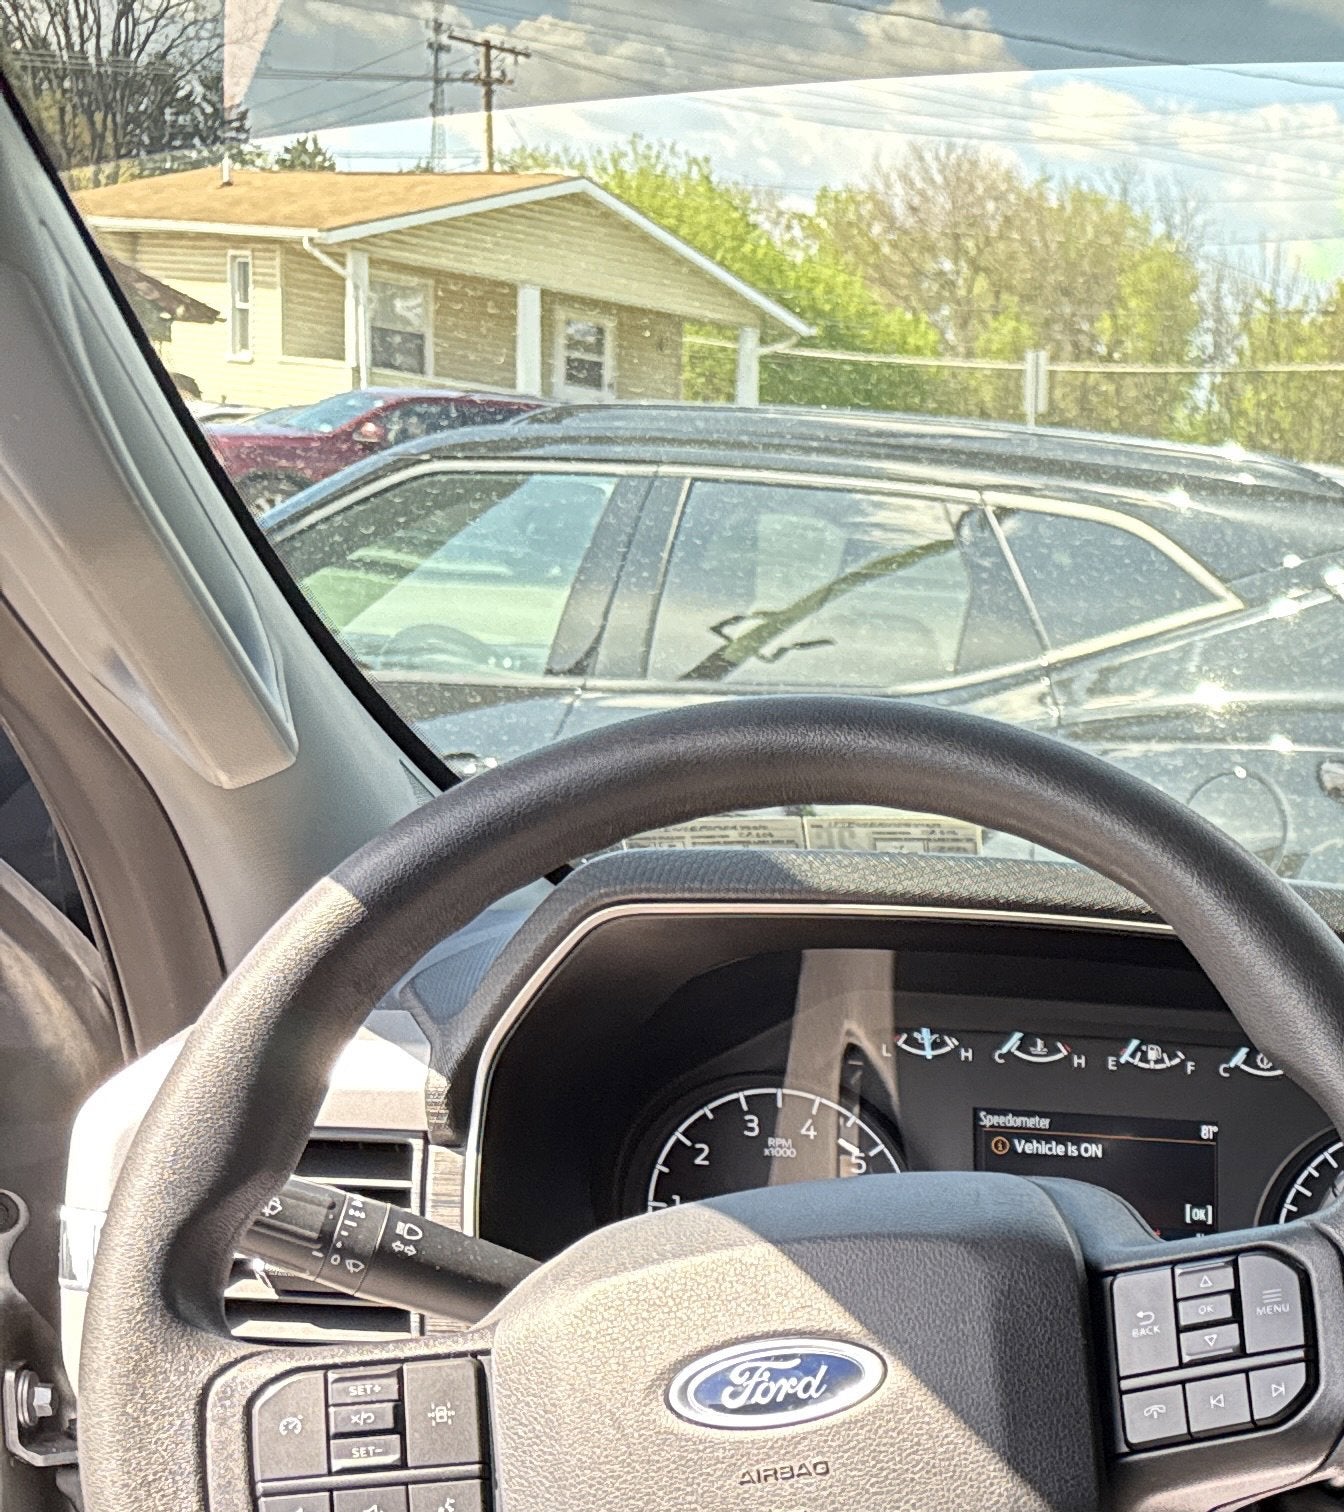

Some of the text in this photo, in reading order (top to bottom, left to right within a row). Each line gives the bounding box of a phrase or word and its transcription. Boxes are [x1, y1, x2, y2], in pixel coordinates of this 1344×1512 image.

[960, 1048, 973, 1062] H
[994, 1050, 1006, 1064] C
[1073, 1055, 1086, 1069] H
[1107, 1057, 1118, 1071] E
[1186, 1061, 1196, 1075] F
[1219, 1064, 1230, 1078] C
[743, 1115, 760, 1137] 3
[979, 1111, 1051, 1130] Speedometer
[800, 1119, 817, 1140] 4
[767, 1138, 793, 1147] RPM
[1014, 1138, 1103, 1159] Vehicle is ON
[693, 1143, 710, 1166] 2
[850, 1150, 867, 1174] 5
[1198, 1304, 1214, 1315] OK
[1256, 1303, 1290, 1316] MENU
[1131, 1325, 1161, 1338] BACK
[720, 1358, 828, 1409] Ford
